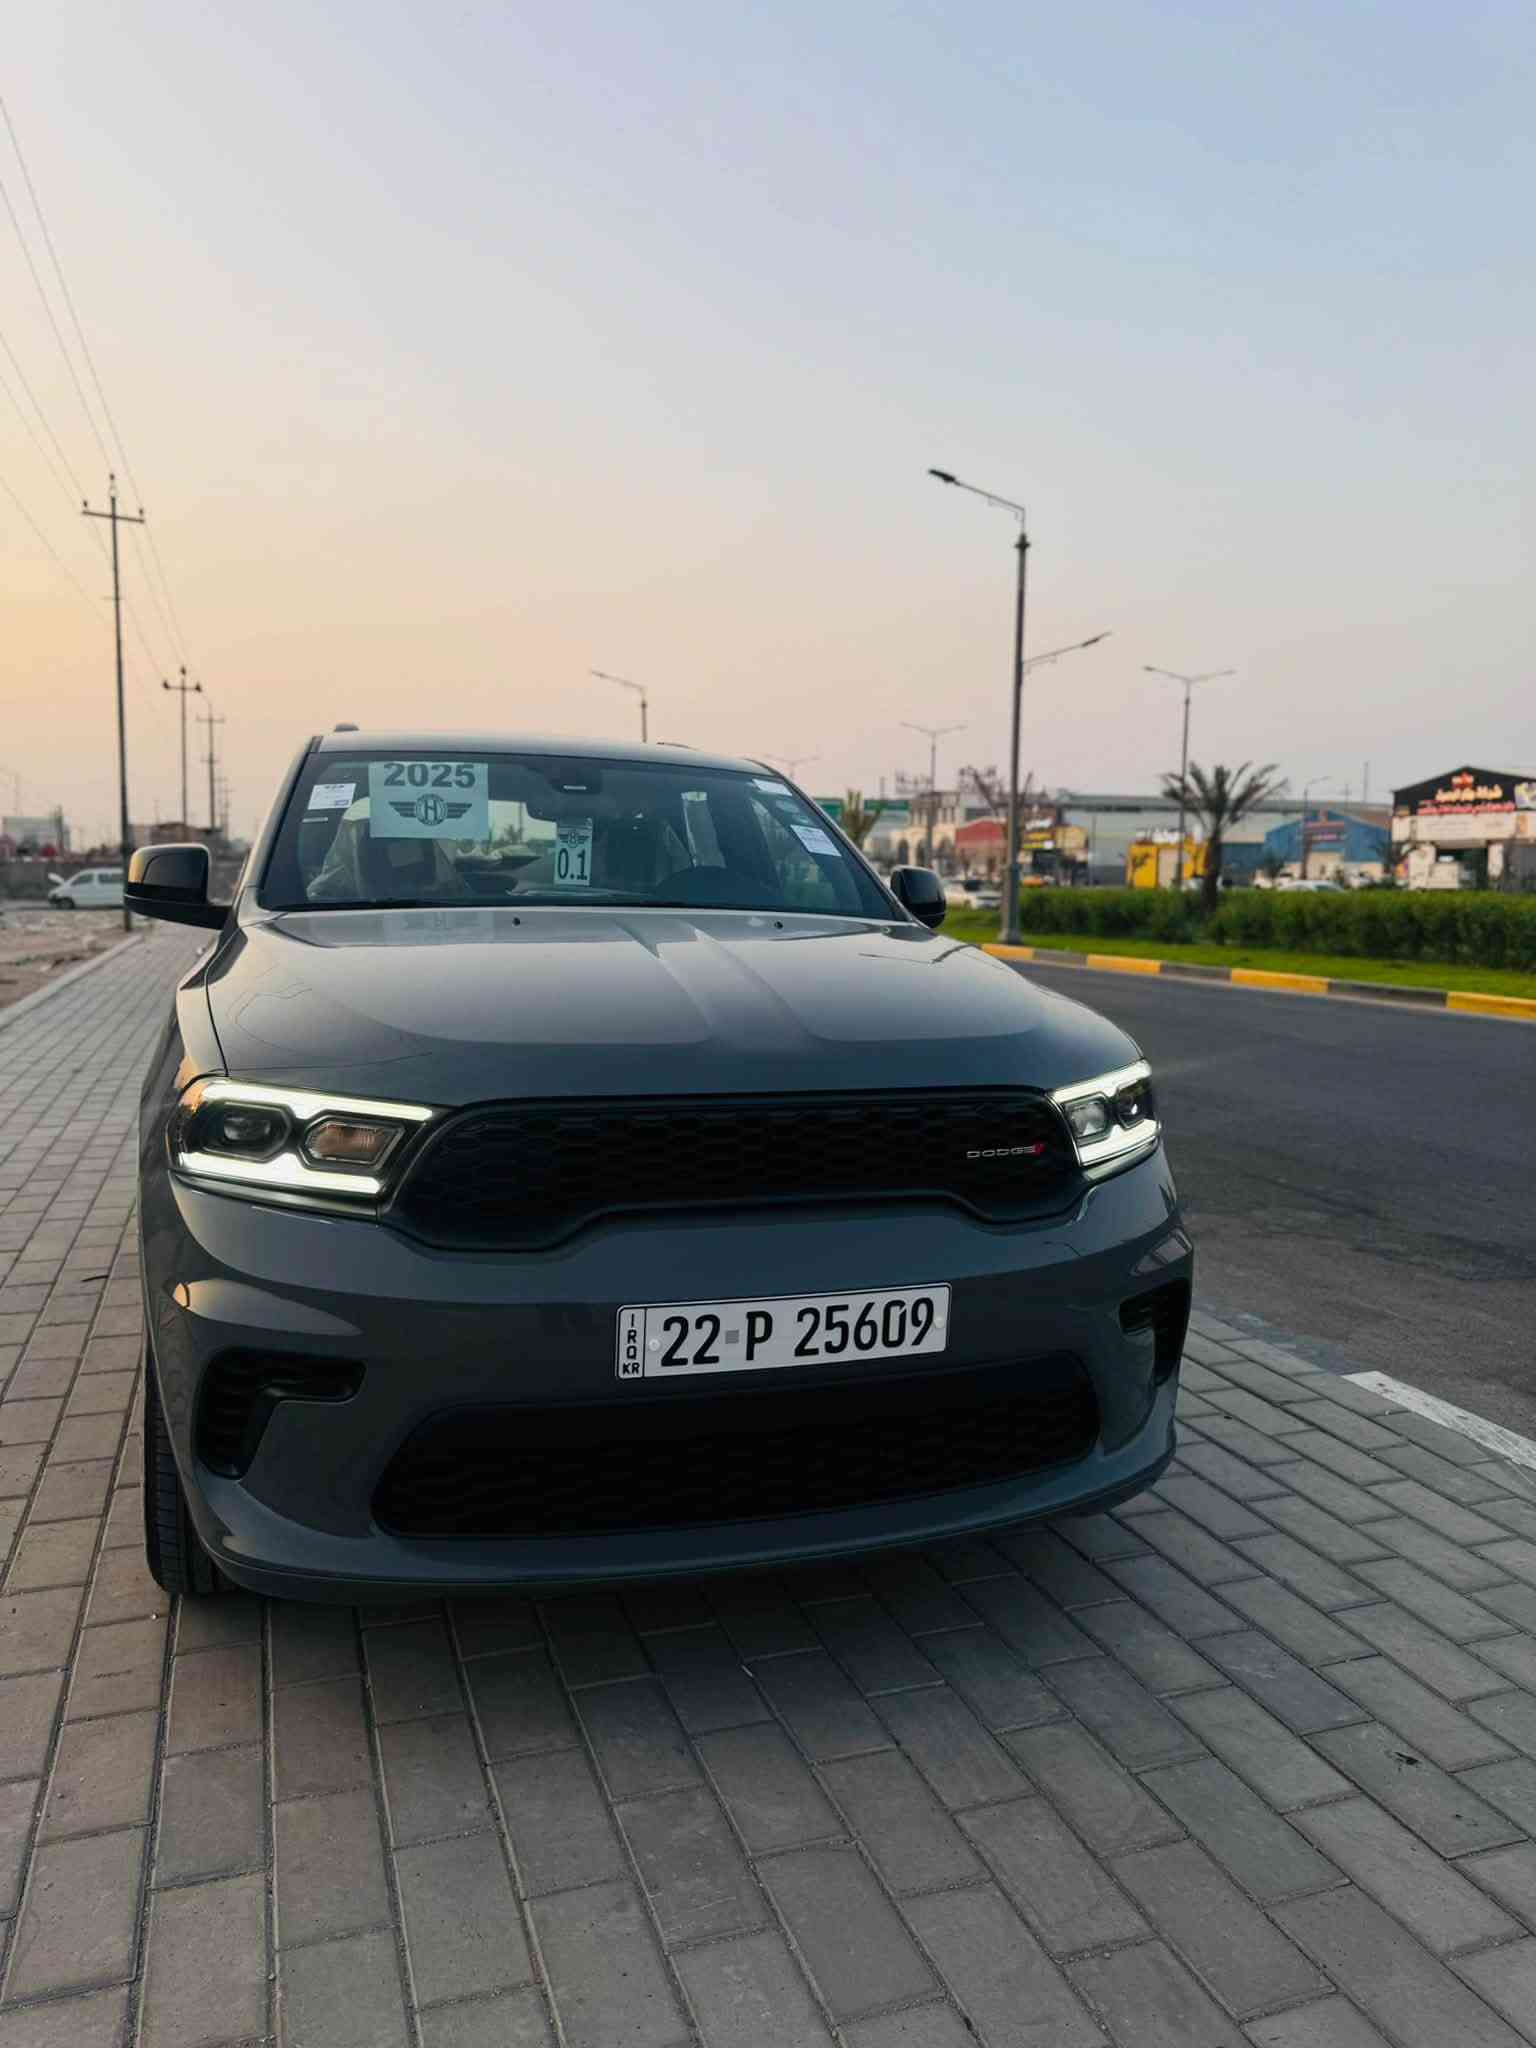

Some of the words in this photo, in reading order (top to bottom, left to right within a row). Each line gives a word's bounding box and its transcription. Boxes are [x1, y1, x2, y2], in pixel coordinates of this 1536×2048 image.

[384, 763, 476, 788] 2025
[558, 848, 588, 880] 0.1
[966, 1145, 1036, 1158] DODGE
[660, 1314, 721, 1367] 22
[745, 1310, 773, 1361] P
[794, 1297, 935, 1357] 25609
[622, 1362, 640, 1375] KR
